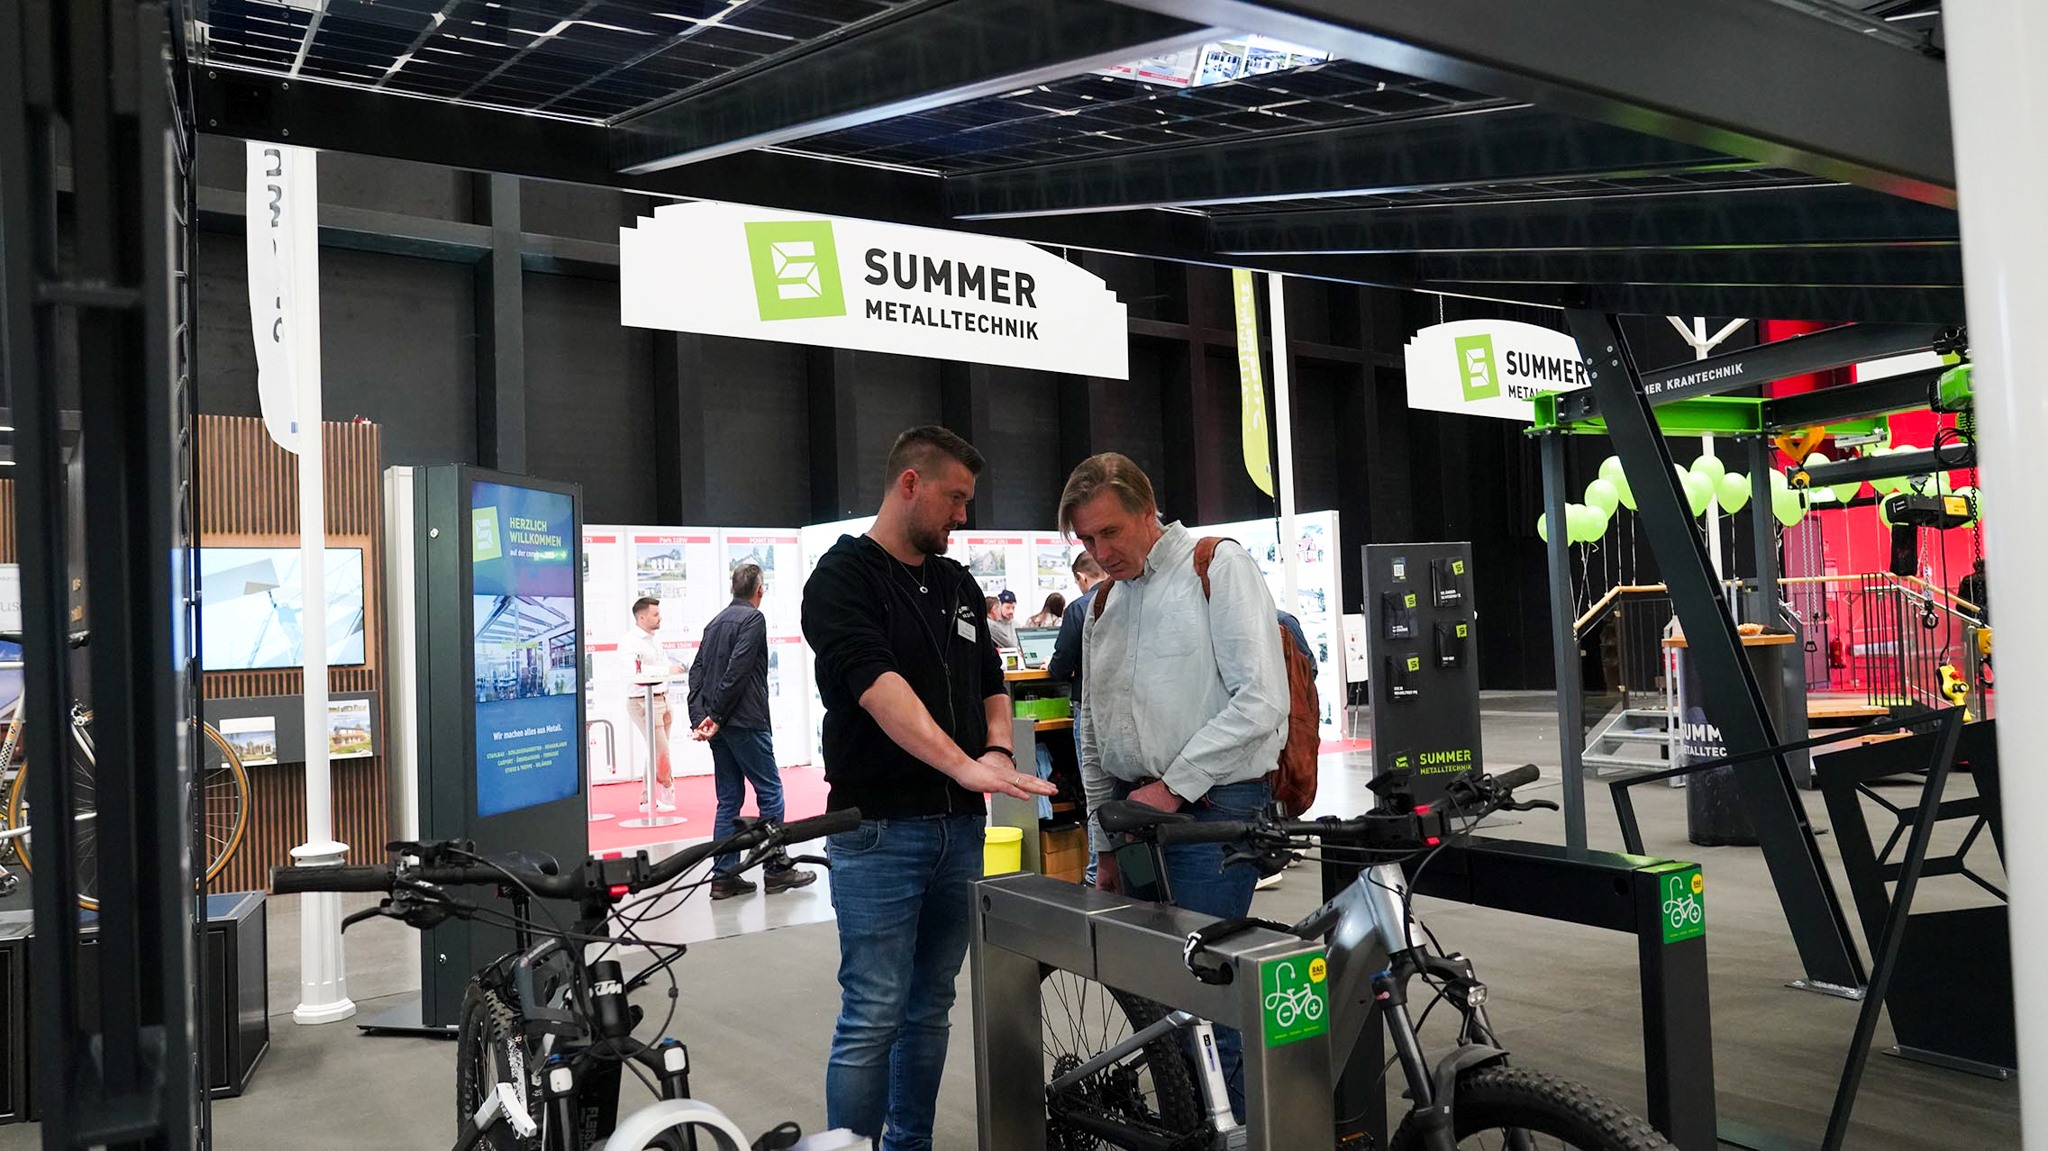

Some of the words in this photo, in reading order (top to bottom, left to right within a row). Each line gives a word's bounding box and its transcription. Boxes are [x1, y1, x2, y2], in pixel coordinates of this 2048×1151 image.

[864, 247, 1037, 309] SUMMER
[865, 298, 1039, 341] METALLTECHNIK
[1506, 350, 1587, 385] SUMMER
[1666, 363, 1743, 390] KRANTECHNIK
[509, 517, 547, 532] HERZLICH
[509, 531, 562, 547] WILLKOMMEN
[493, 731, 504, 741] Wir
[503, 729, 524, 739] machen
[524, 727, 537, 736] alles
[537, 726, 546, 734] aus
[1683, 723, 1723, 742] UMM
[1419, 749, 1472, 765] SUMMER
[1420, 763, 1473, 775] METALLTECHNIK
[1311, 964, 1325, 973] RAD
